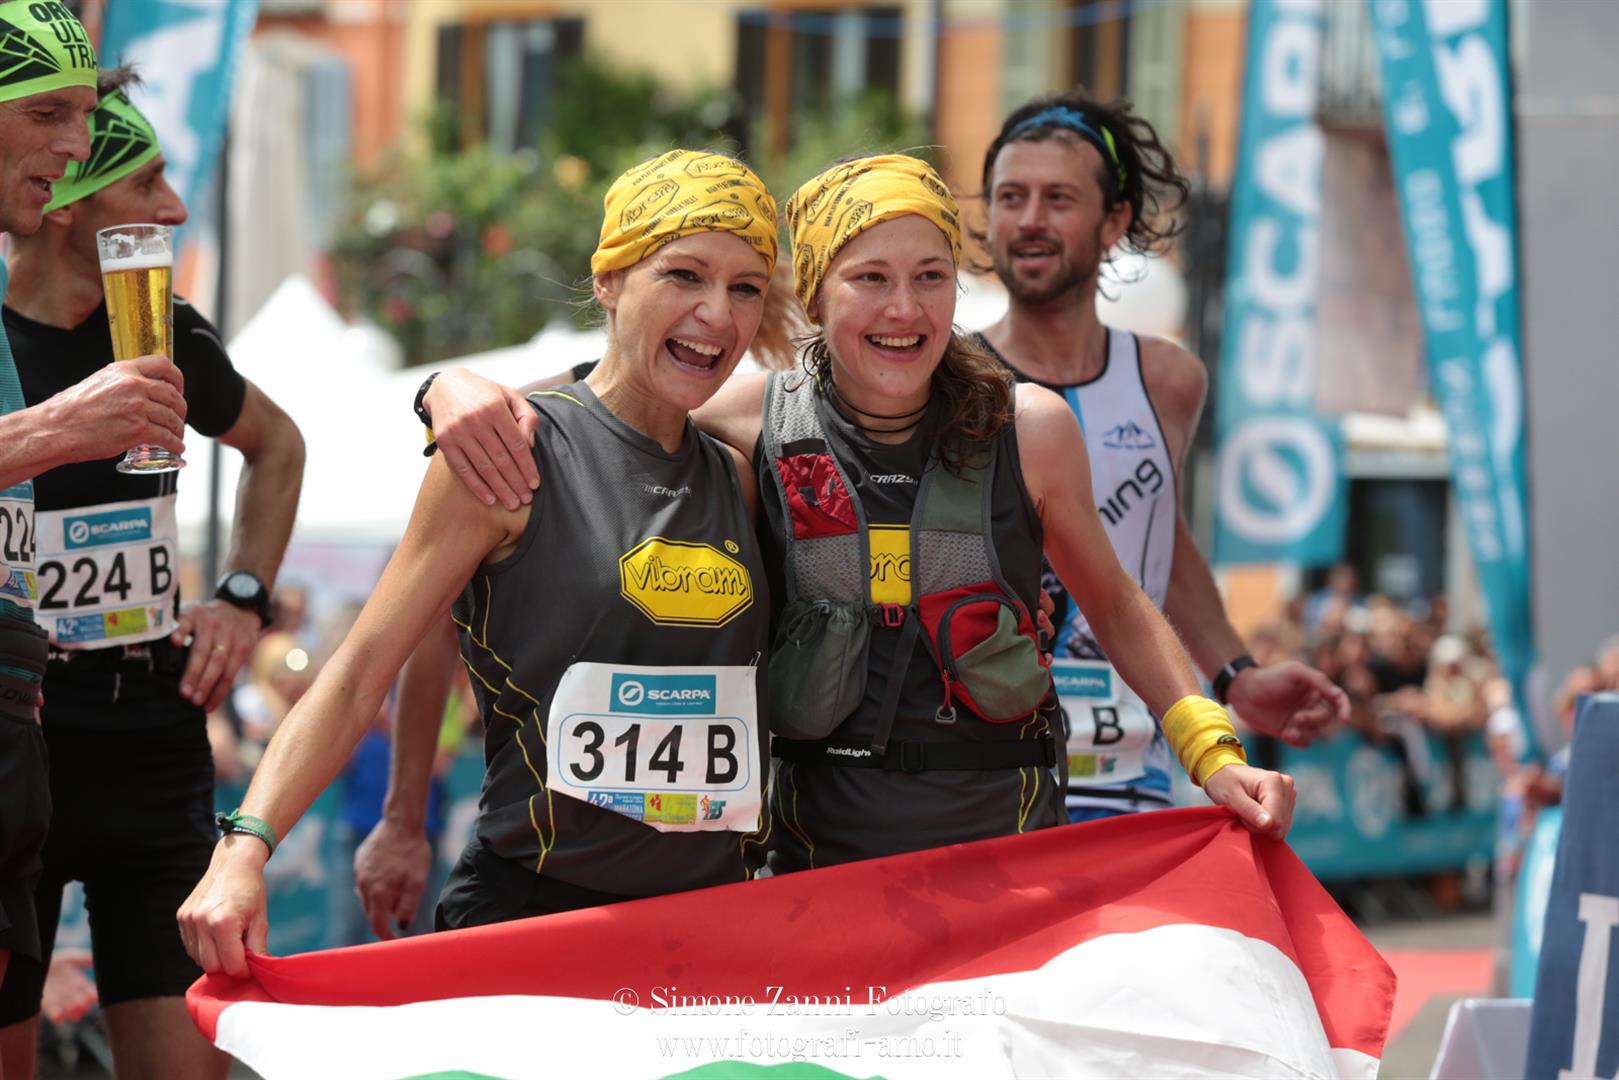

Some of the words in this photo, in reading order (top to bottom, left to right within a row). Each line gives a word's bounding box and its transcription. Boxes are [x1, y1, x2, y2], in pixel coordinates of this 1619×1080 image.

[870, 474, 914, 484] CRAZY
[90, 518, 148, 534] SCARPA
[37, 551, 132, 611] 224
[149, 545, 173, 596] B
[647, 689, 711, 700] SCARPA
[1092, 706, 1125, 746] B
[569, 721, 684, 783] 314
[705, 724, 739, 784] B
